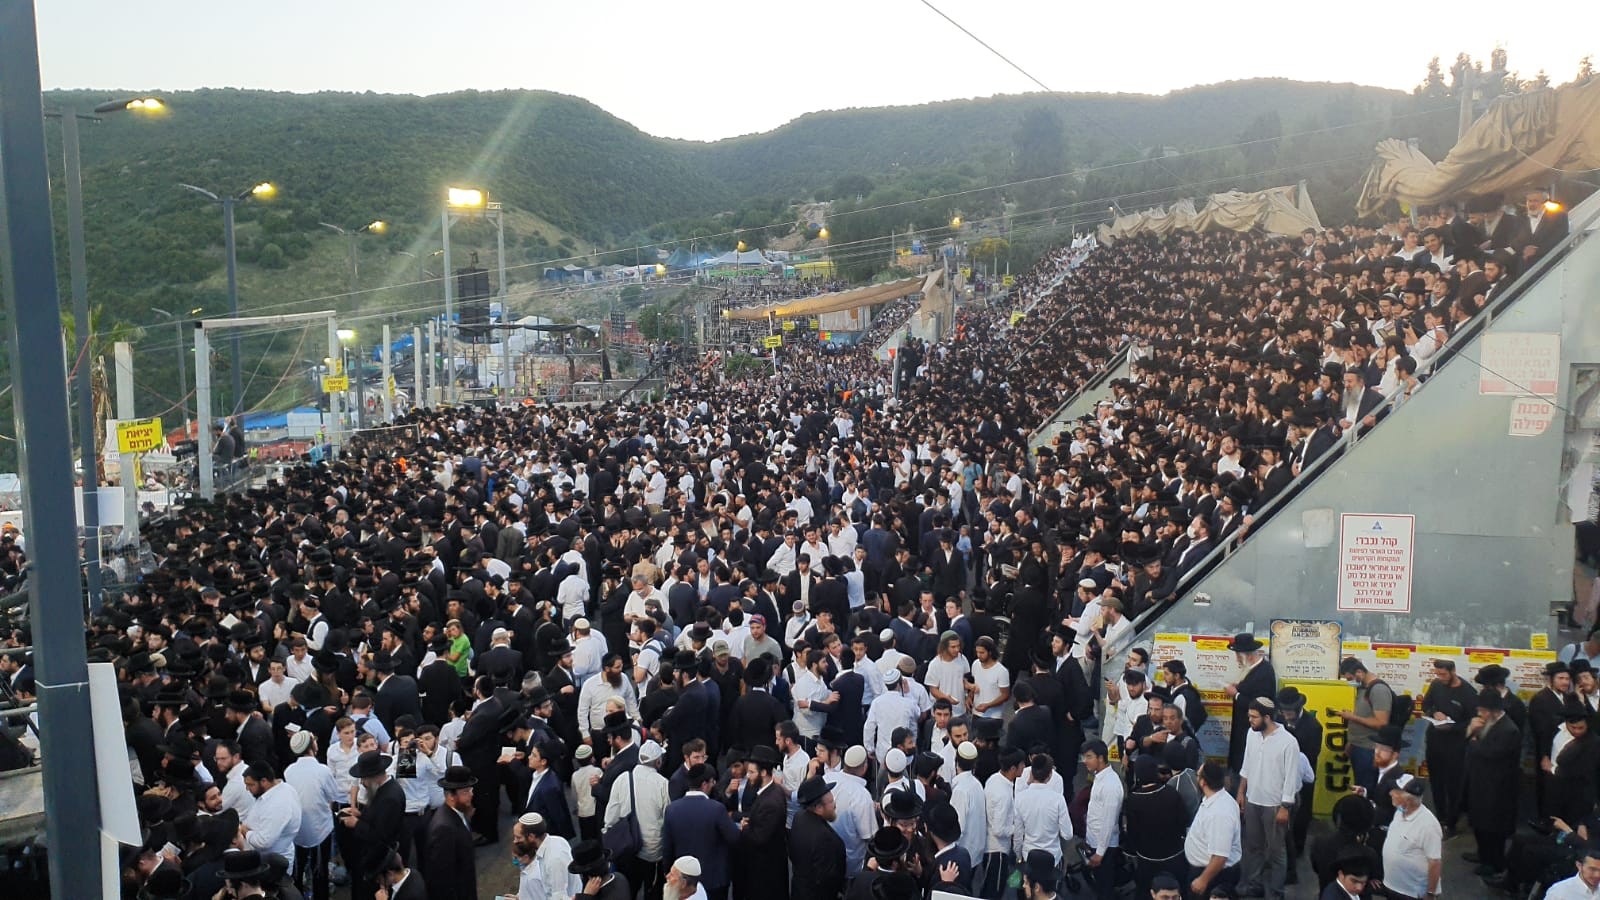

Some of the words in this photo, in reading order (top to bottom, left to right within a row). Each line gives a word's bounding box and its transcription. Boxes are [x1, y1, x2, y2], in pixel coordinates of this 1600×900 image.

[1517, 403, 1549, 415] סכנת
[126, 428, 153, 439] יציאת
[129, 439, 152, 449] חרום
[1355, 536, 1378, 546] נכבד!
[1381, 537, 1398, 547] קהל
